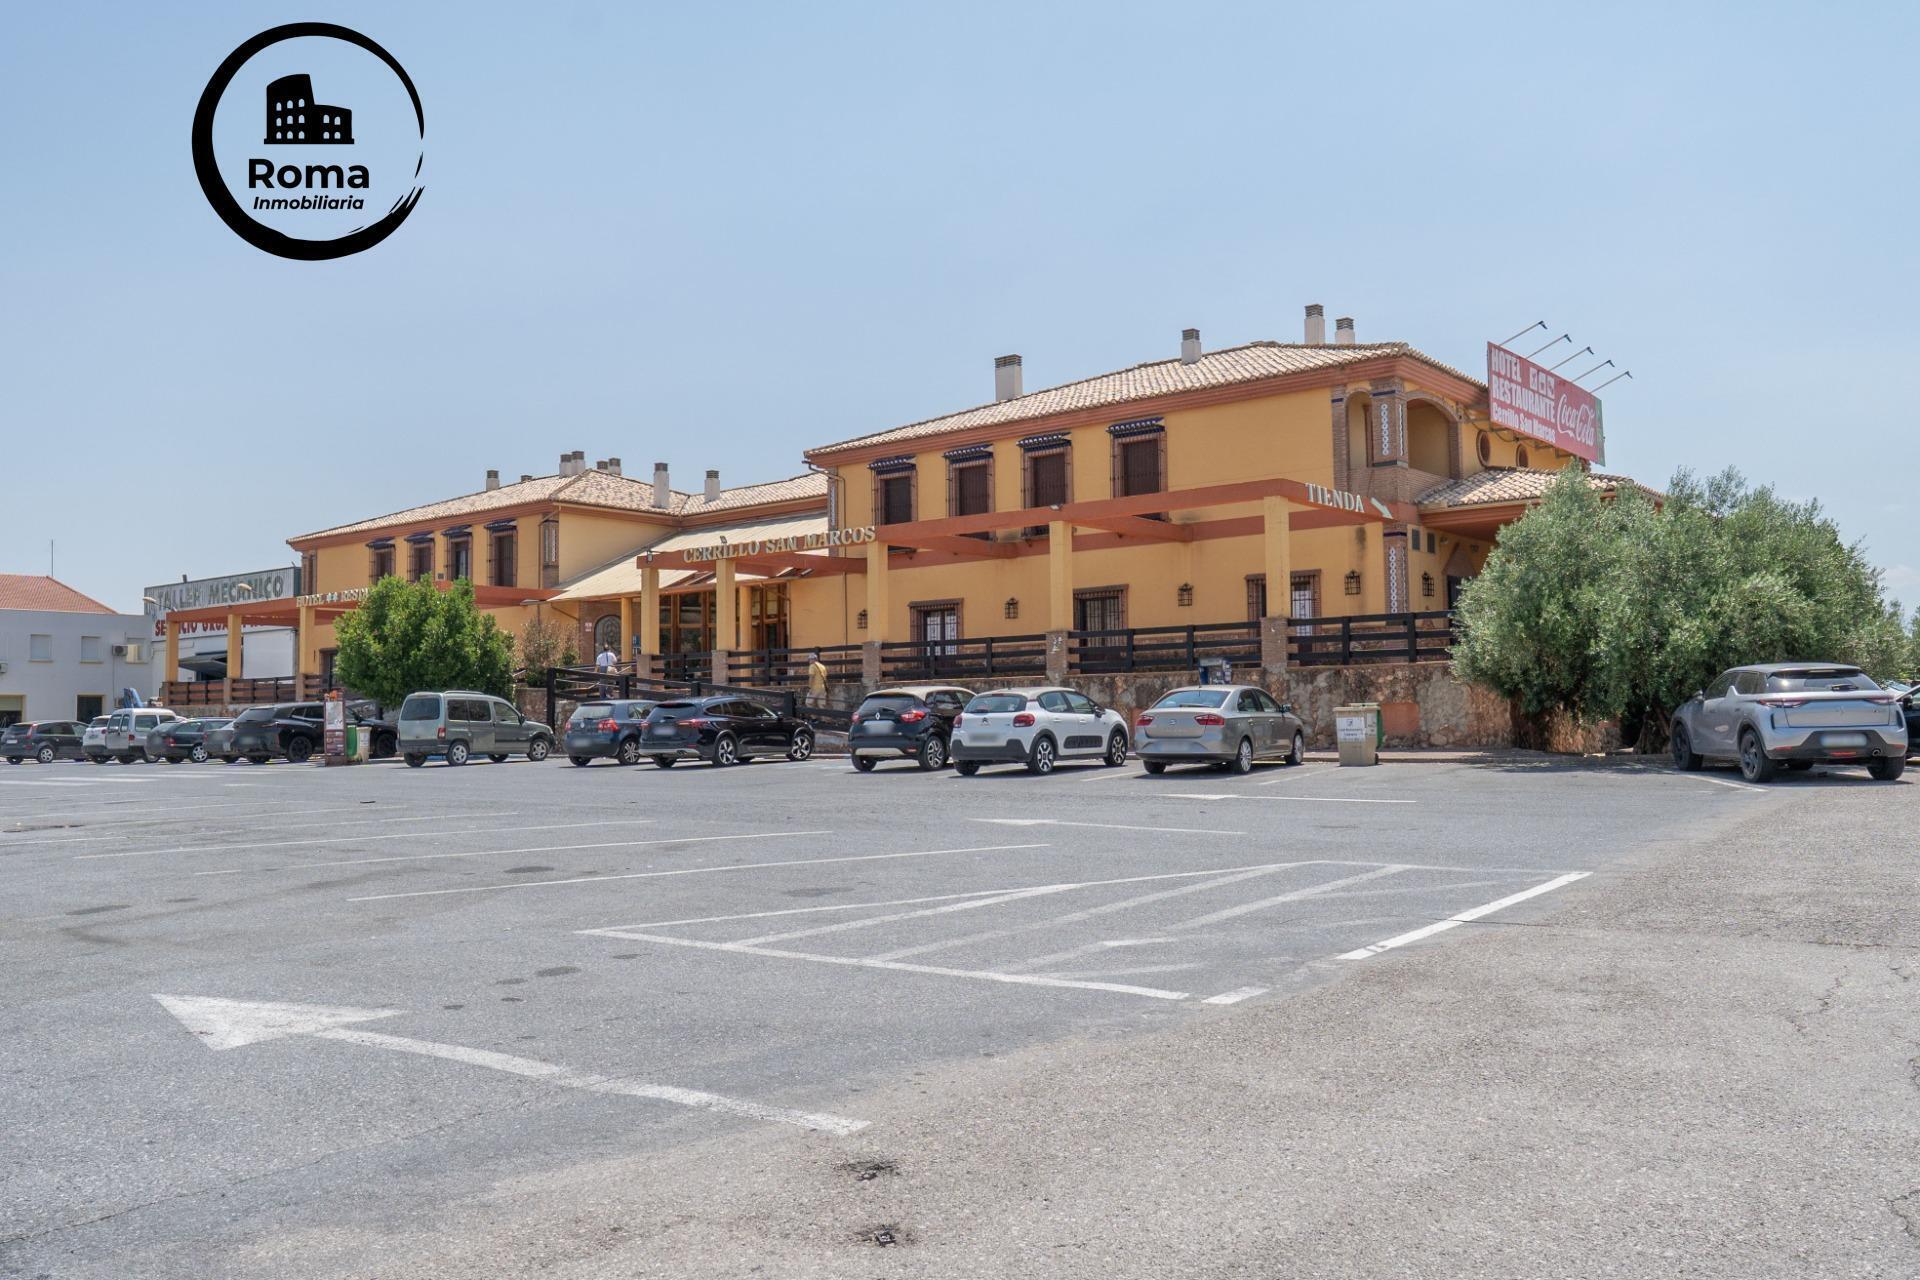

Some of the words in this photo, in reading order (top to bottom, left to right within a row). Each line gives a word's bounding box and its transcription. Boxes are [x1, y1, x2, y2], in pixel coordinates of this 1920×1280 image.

[1491, 346, 1522, 382] HOTEL
[1492, 374, 1555, 424] RESTAURANTE
[1493, 402, 1519, 430] Cerrillo
[1519, 412, 1533, 434] San
[1532, 417, 1556, 444] Marcos
[1305, 482, 1365, 513] TIENDA
[683, 540, 761, 563] CERRILLO
[765, 535, 798, 554] SAN
[803, 525, 876, 549] MARCOS
[296, 592, 325, 608] HOTEL
